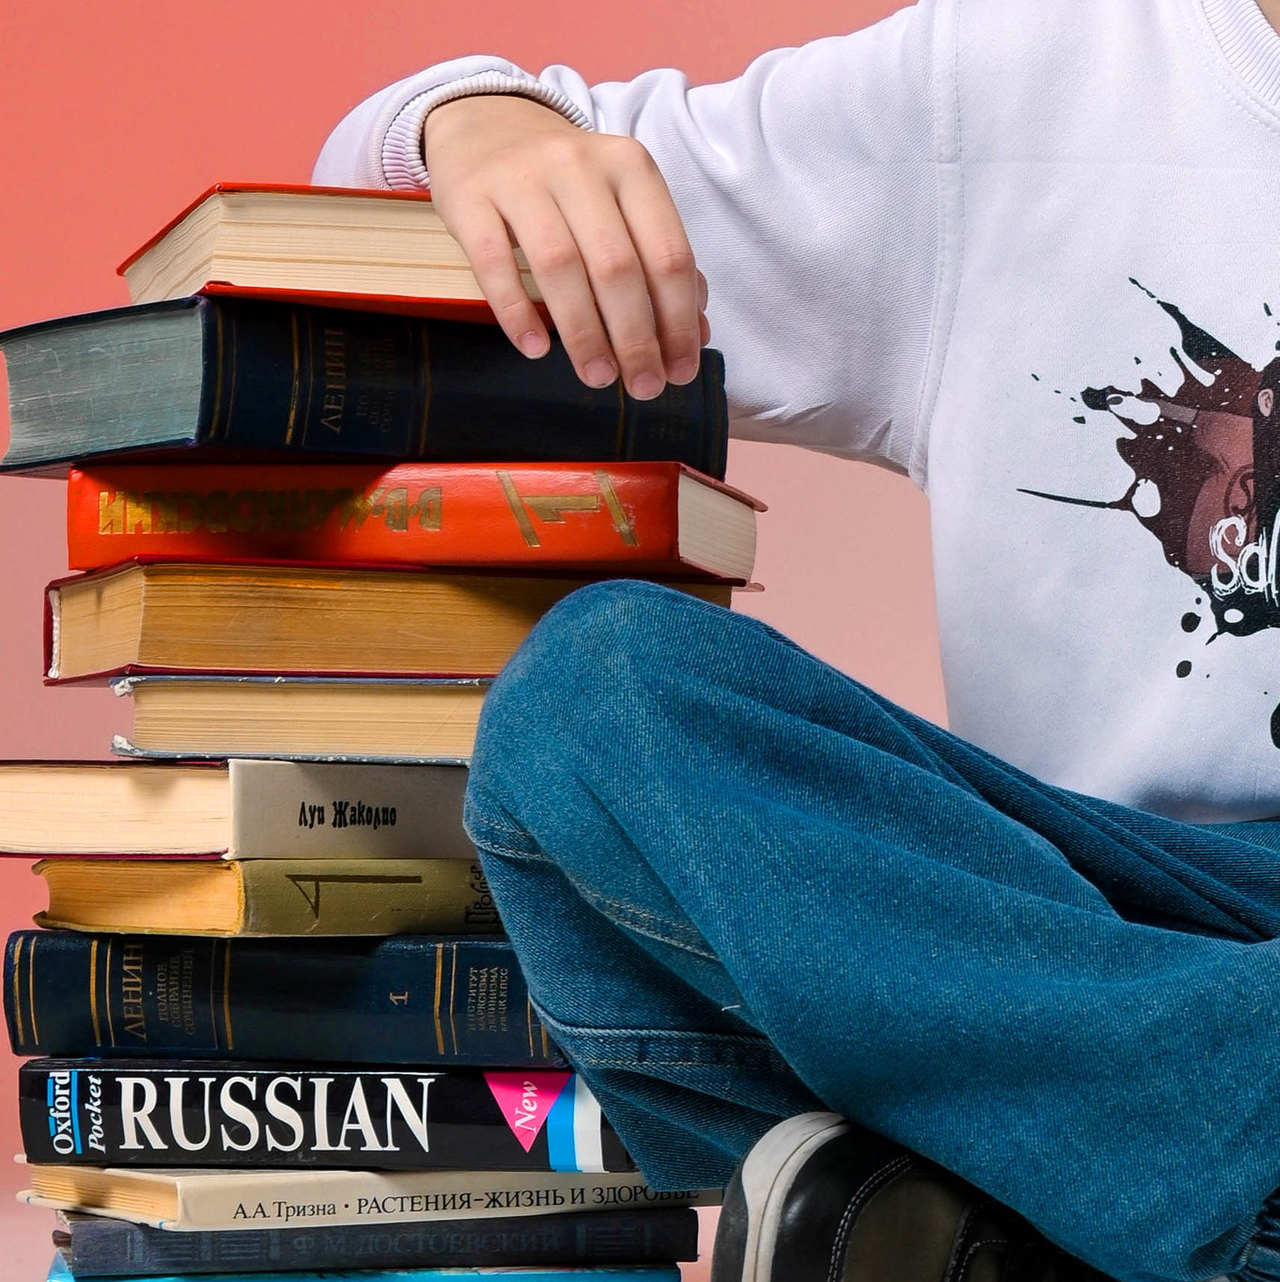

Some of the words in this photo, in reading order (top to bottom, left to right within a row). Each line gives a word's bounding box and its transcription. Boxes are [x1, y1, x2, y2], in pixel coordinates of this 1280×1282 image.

[298, 800, 326, 830] Луи
[331, 799, 397, 831] Жаколио
[121, 942, 148, 1043] ЛЕНИН
[156, 963, 170, 1022] ПОЛНОЕ
[169, 955, 182, 1028] СОБРАНИЕ
[389, 990, 410, 1007] 1
[466, 966, 479, 1032] ИНСТИТУТ
[49, 1071, 74, 1155] Oxford
[84, 1074, 107, 1155] Pocket
[115, 1076, 436, 1154] RUSSIAN
[514, 1080, 539, 1134] New
[570, 1188, 588, 1205] И
